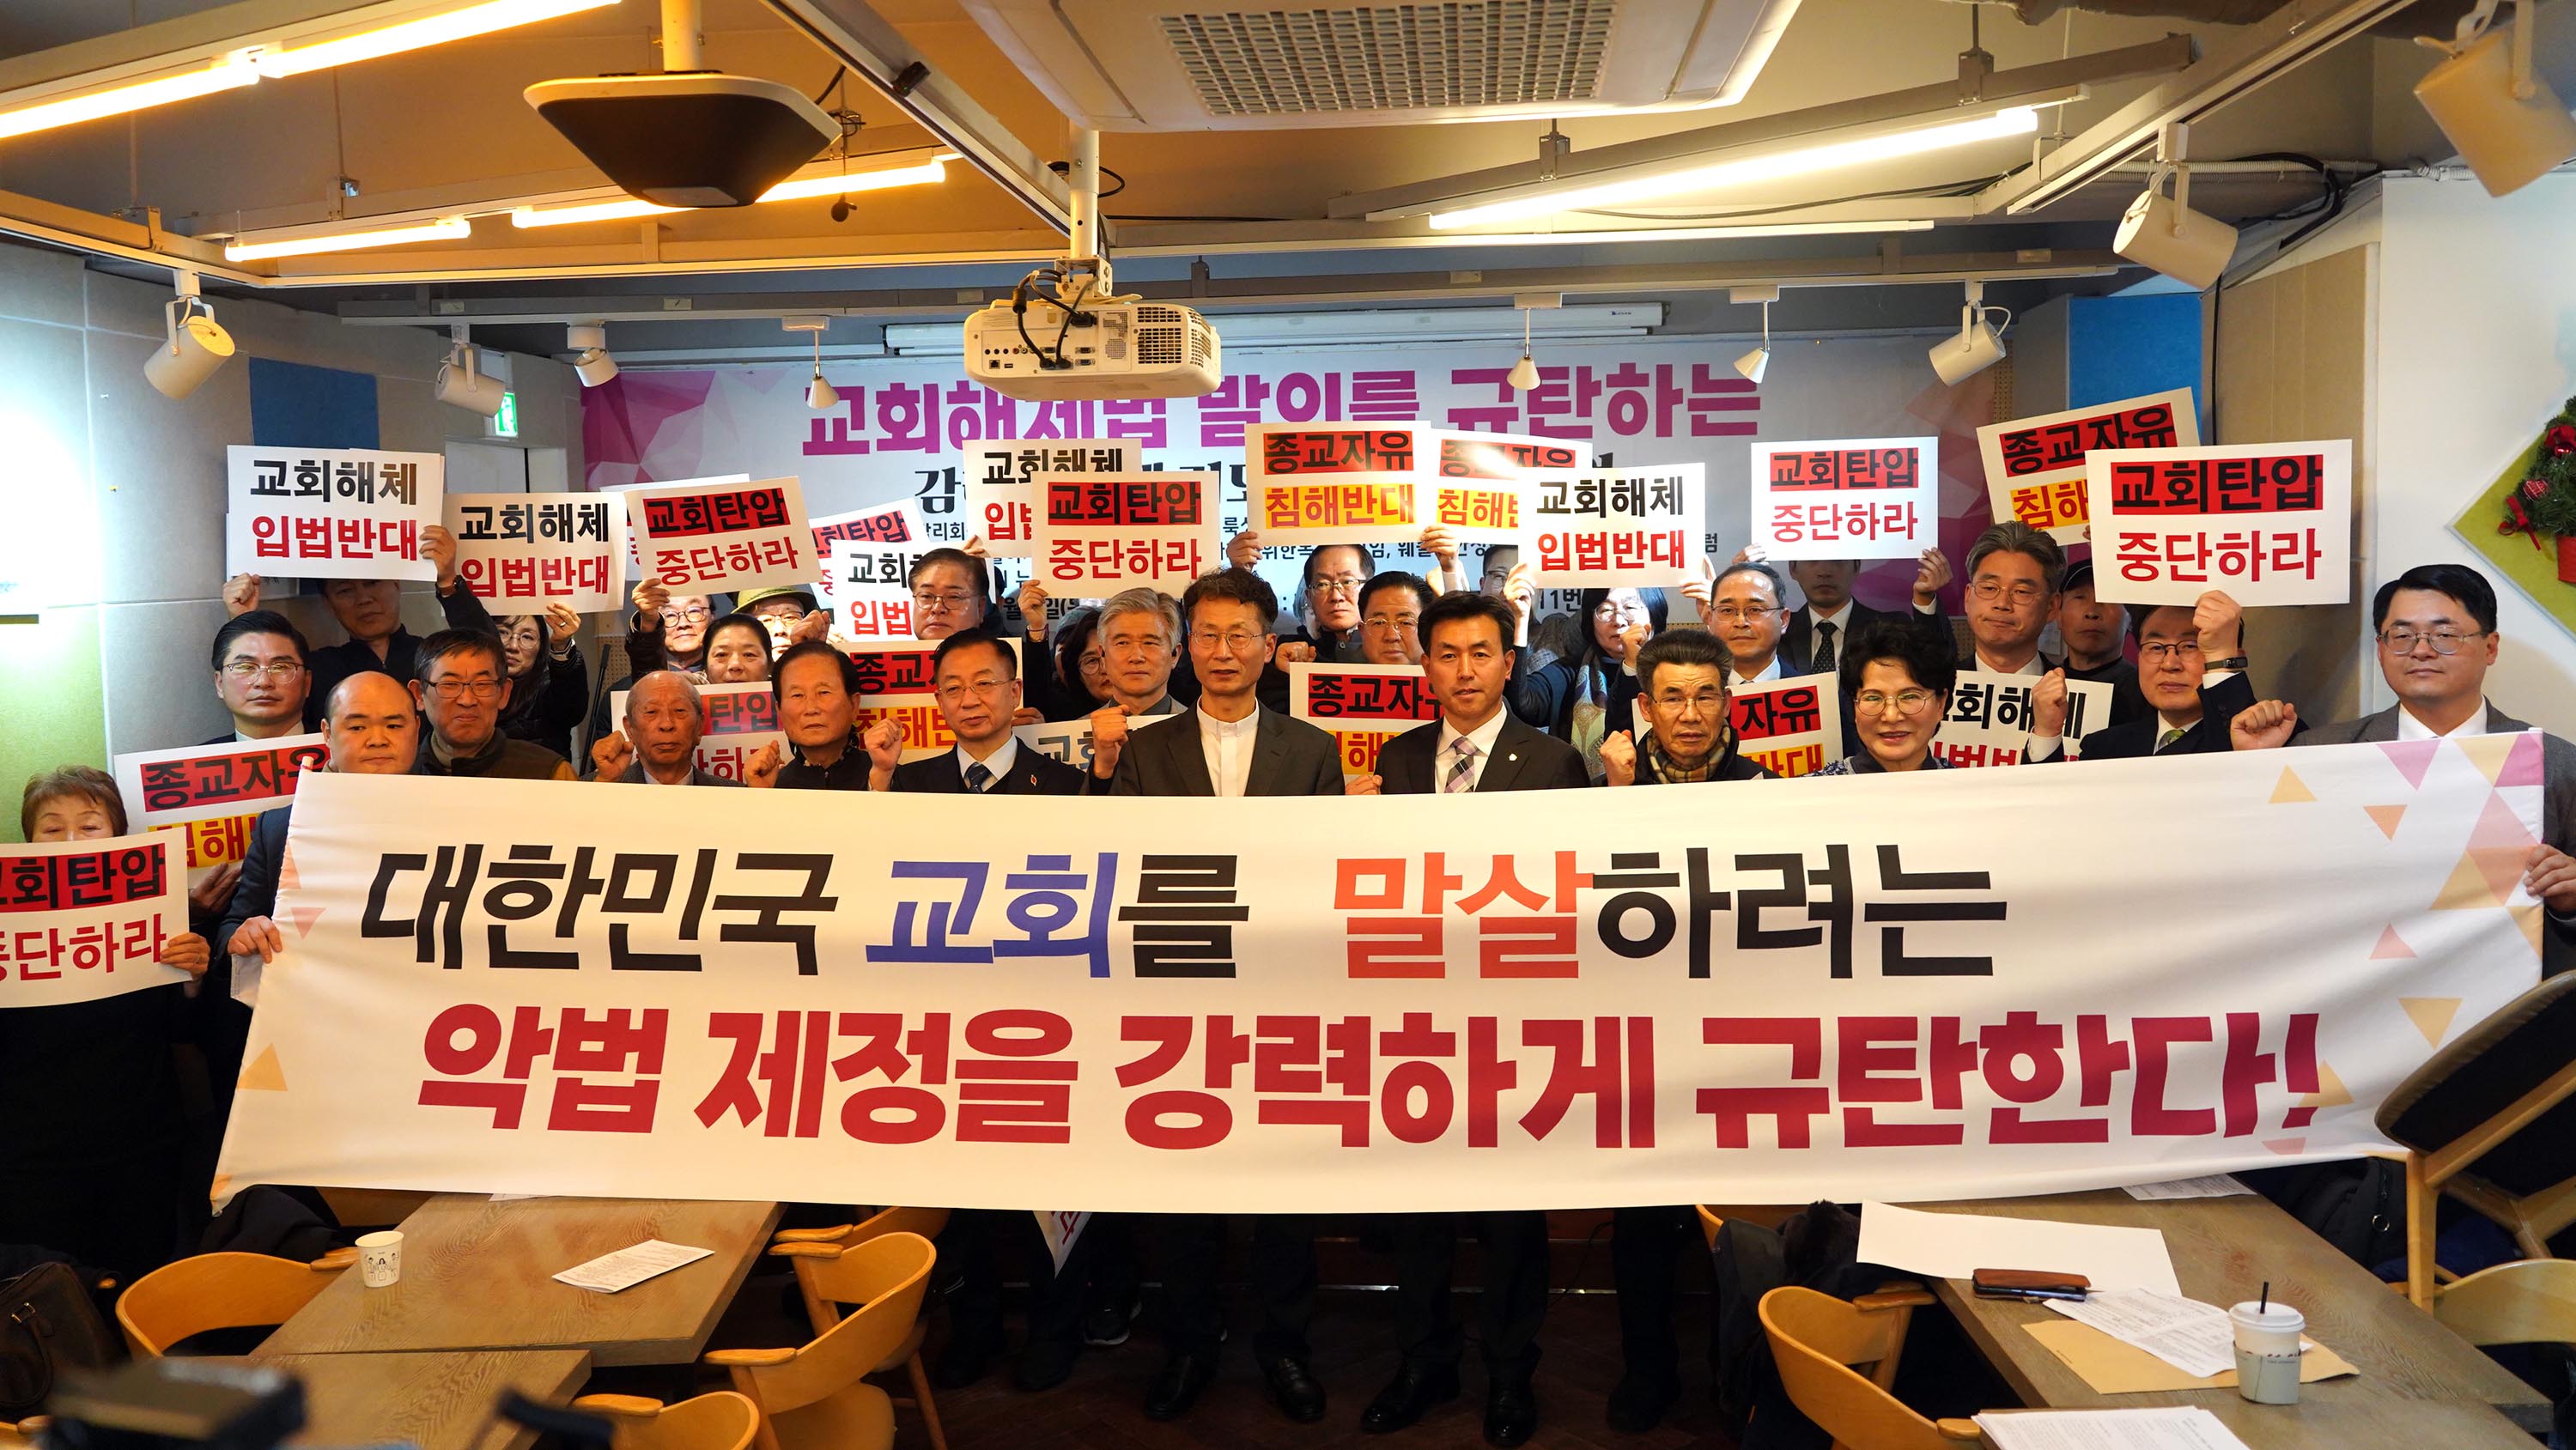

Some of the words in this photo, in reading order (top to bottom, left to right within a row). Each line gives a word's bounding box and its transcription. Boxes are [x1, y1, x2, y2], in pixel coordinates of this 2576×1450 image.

[1448, 362, 1760, 438] 규탄하는
[1265, 431, 1413, 473] 종교자유
[2004, 408, 2175, 474] 종교자유
[250, 459, 416, 505] 교회해체
[1771, 449, 1918, 489] 교회탄압
[2113, 457, 2323, 512] 교회탄압
[647, 488, 785, 533] 교회탄압
[1048, 482, 1200, 524] 교회탄압
[1267, 484, 1413, 527] 침해반대
[1438, 489, 1518, 528] 침해
[1537, 476, 1683, 518] 교회해체
[2014, 479, 2088, 529] 침해
[252, 515, 416, 561] 입법반대
[459, 502, 609, 543] 교회해체
[1772, 501, 1918, 542] 중단하라
[656, 537, 799, 585] 중단하라
[848, 553, 922, 588] 교회
[1049, 538, 1201, 580] 중단하라
[1538, 530, 1685, 571] 입법반대
[2116, 529, 2322, 582] 중단하라
[465, 555, 608, 597] 입법반대
[851, 601, 912, 635] 입법
[1739, 689, 1819, 735] 자유
[0, 845, 167, 908] 회탄압
[361, 844, 838, 975] 대한민국
[865, 852, 1249, 978] 교회를
[1334, 845, 2007, 979] 말살하려는
[0, 913, 167, 981] 단하라
[418, 1003, 669, 1133] 악법
[694, 1009, 1078, 1144] 제정을
[1115, 1011, 1656, 1150] 강력하게
[1697, 1011, 2319, 1149] 규탄한다!
